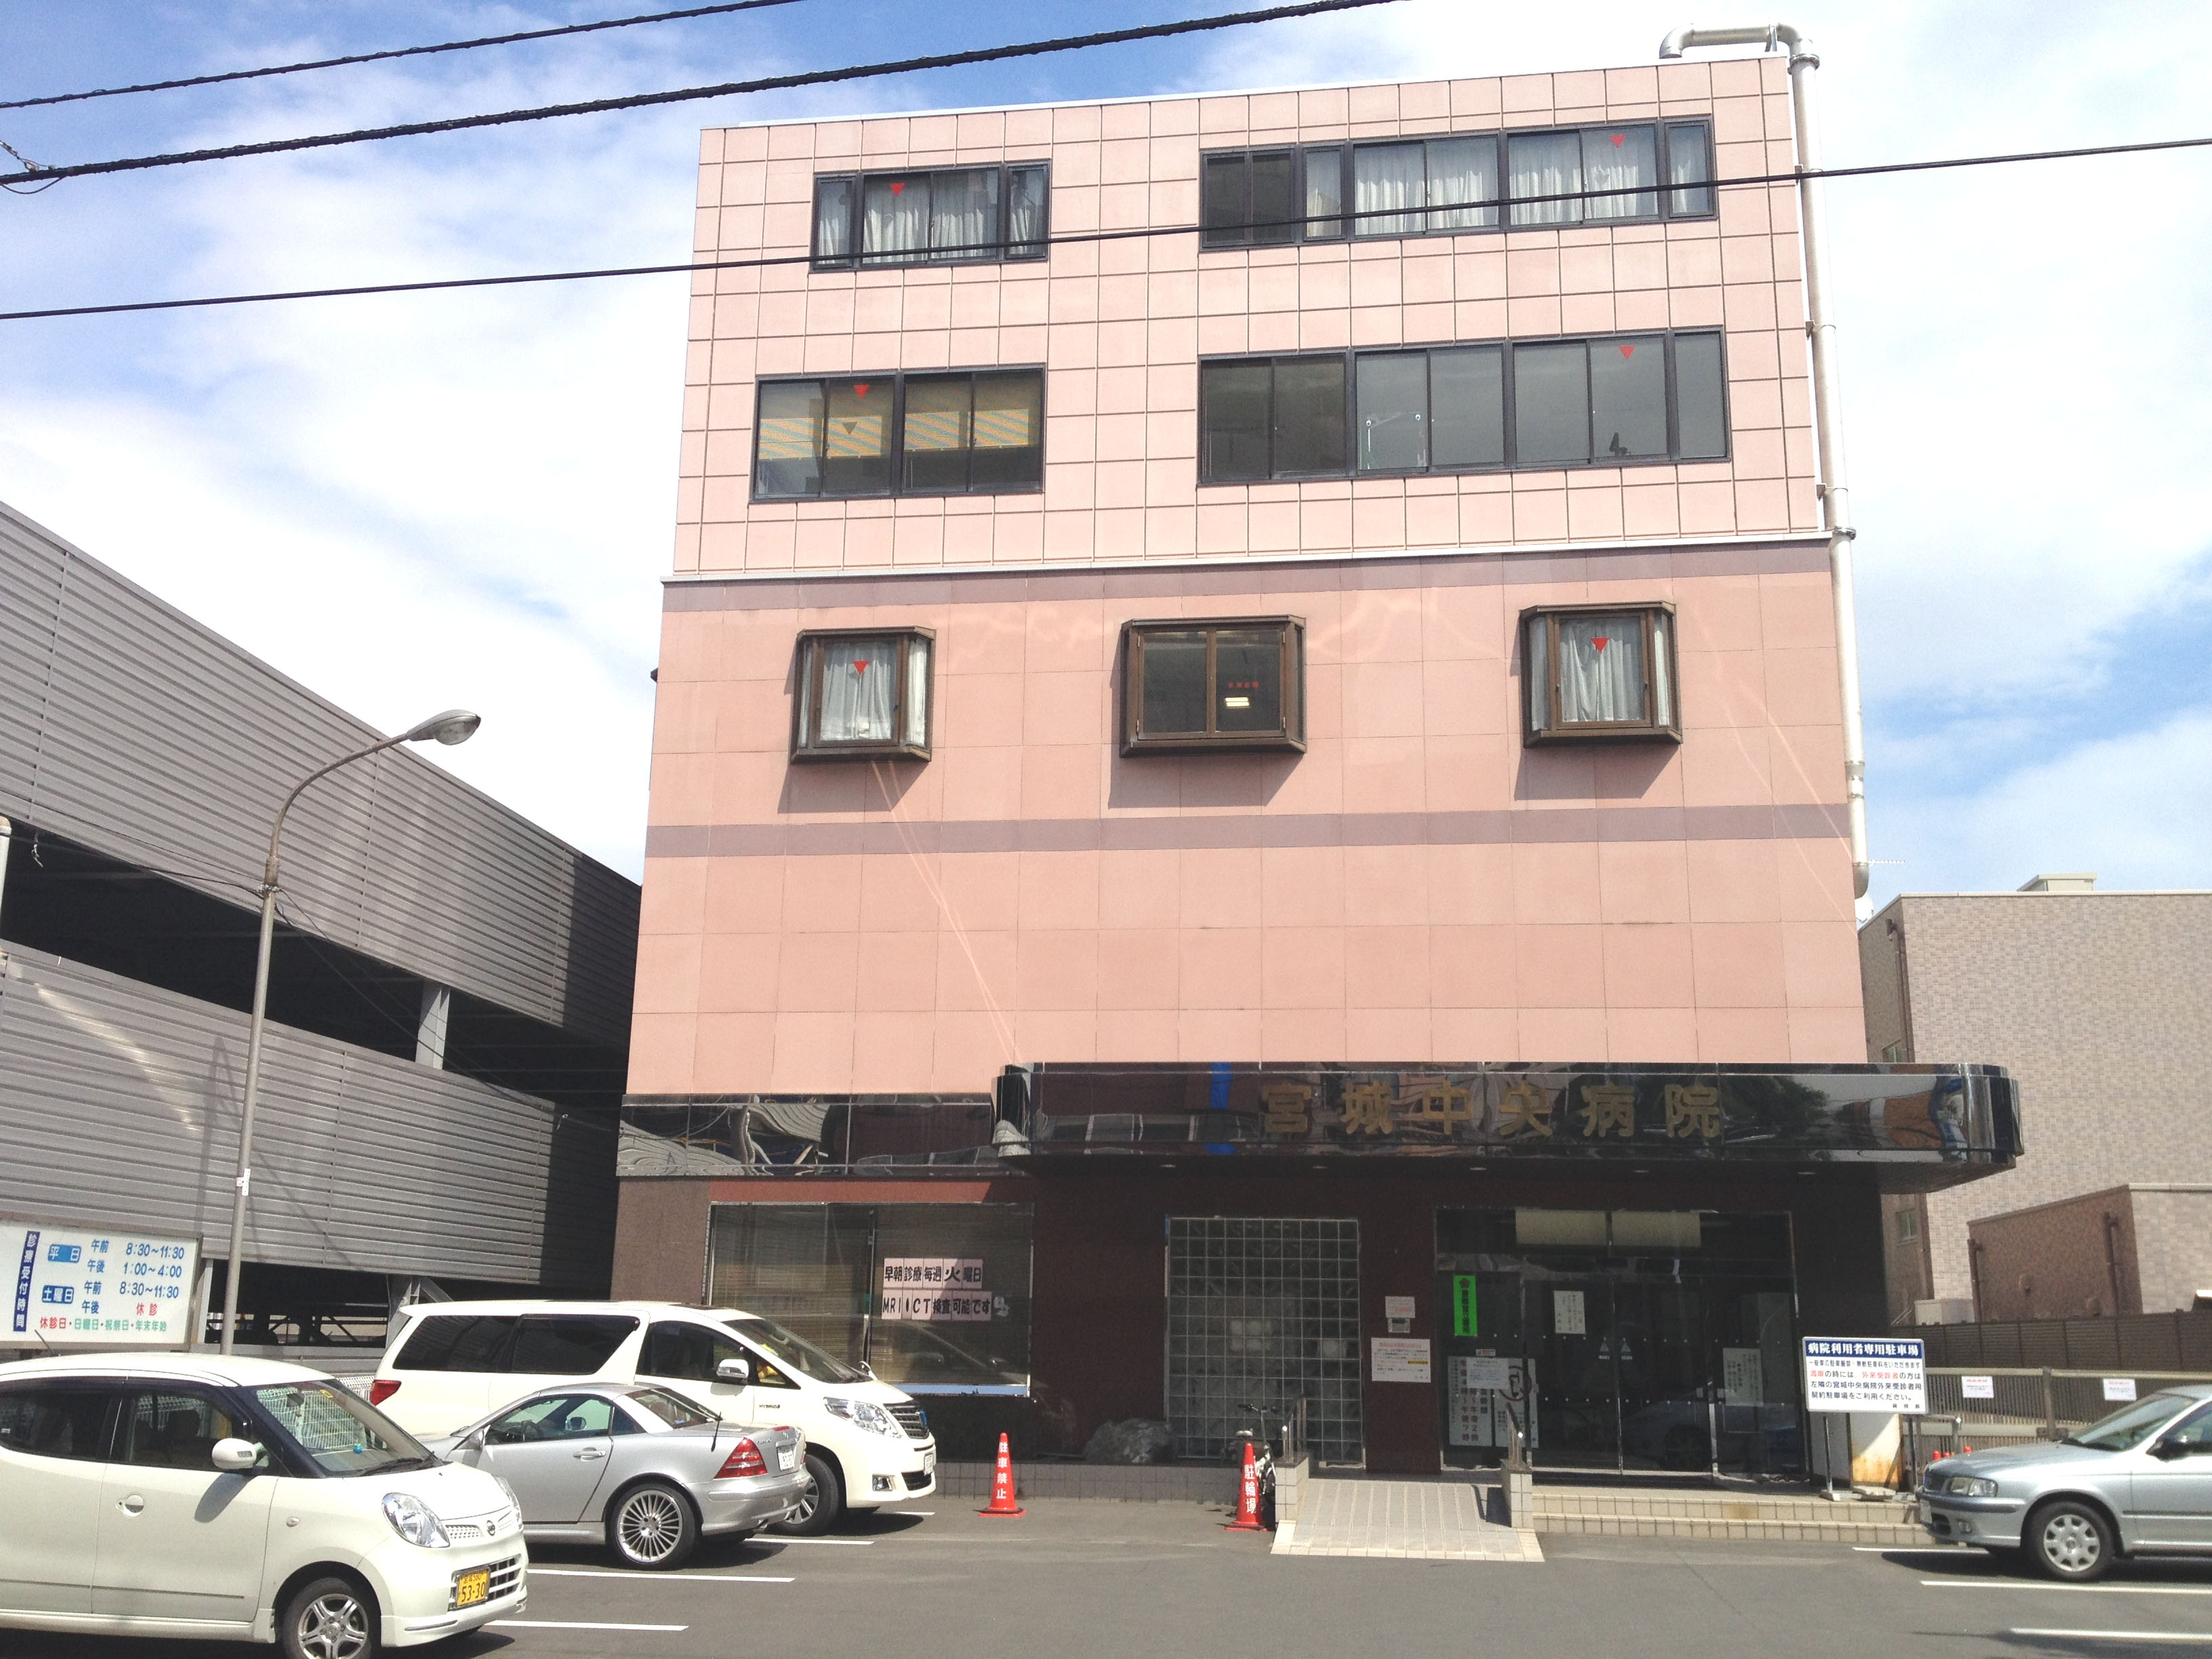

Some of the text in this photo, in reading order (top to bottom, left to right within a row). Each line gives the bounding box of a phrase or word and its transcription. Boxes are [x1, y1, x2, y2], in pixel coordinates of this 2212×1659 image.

[1261, 1081, 1720, 1134] 宮城中央病院
[91, 1239, 109, 1253] 午前
[87, 1259, 105, 1273] 午後
[16, 1233, 37, 1328] 診療受付時間
[43, 1286, 74, 1303] 土曜日
[84, 1280, 102, 1295] 午前
[81, 1300, 99, 1314] 午後
[1808, 1342, 1919, 1356] 病院利用者専用駐車場
[1245, 1465, 1256, 1513] 駐輪場
